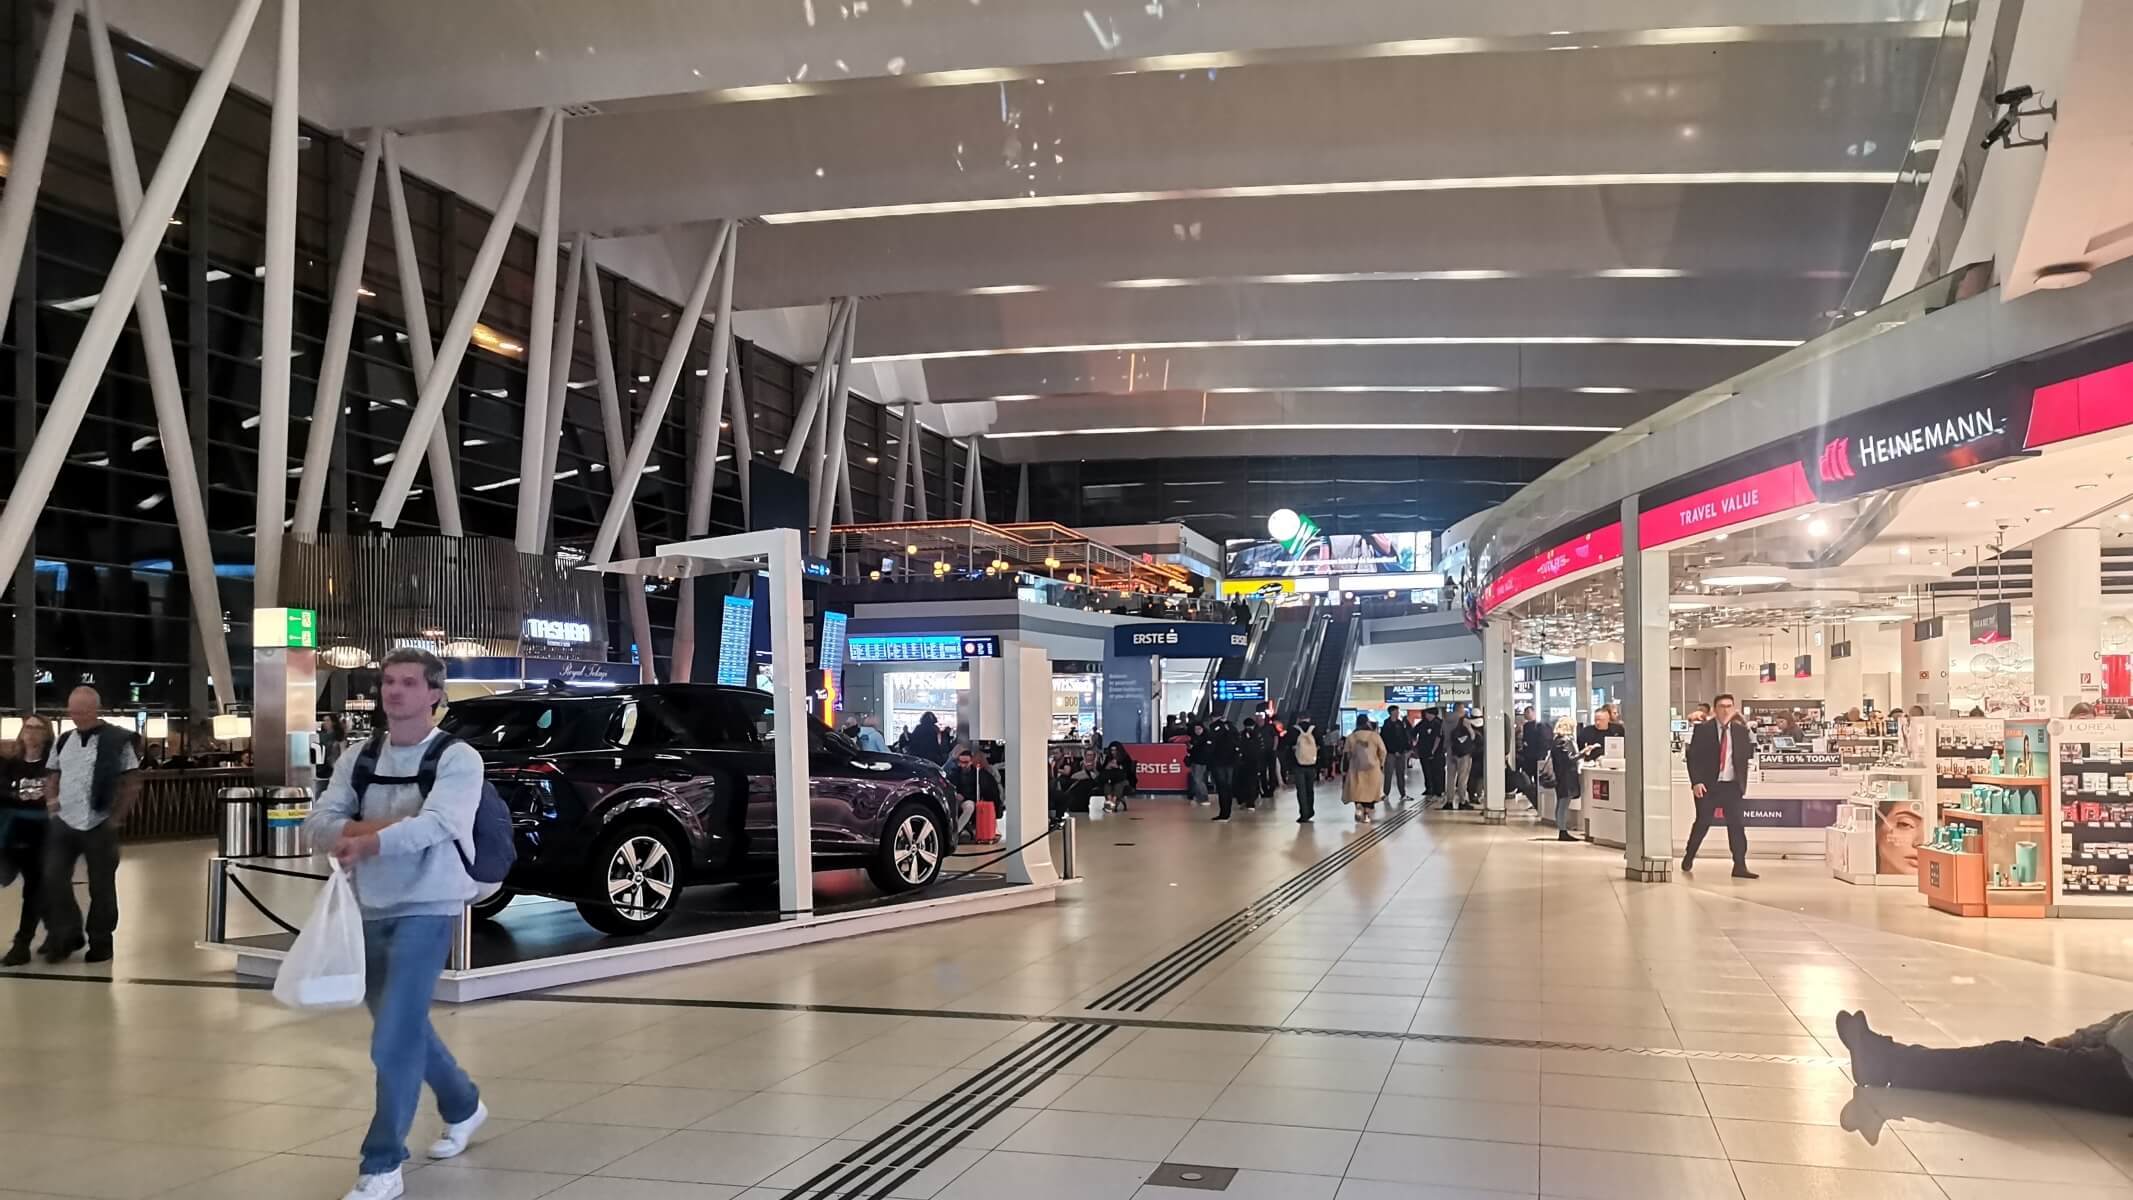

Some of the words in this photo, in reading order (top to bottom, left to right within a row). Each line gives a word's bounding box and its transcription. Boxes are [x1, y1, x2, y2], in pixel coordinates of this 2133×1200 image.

[1858, 408, 1994, 466] HEINEMANN
[1680, 504, 1717, 526] TRAVEL
[1721, 490, 1759, 514] VALUE
[1133, 633, 1164, 644] ERSTE
[1760, 755, 1784, 763] SAVE
[1136, 762, 1168, 774] ERSTE
[1743, 810, 1783, 818] NEMANN
